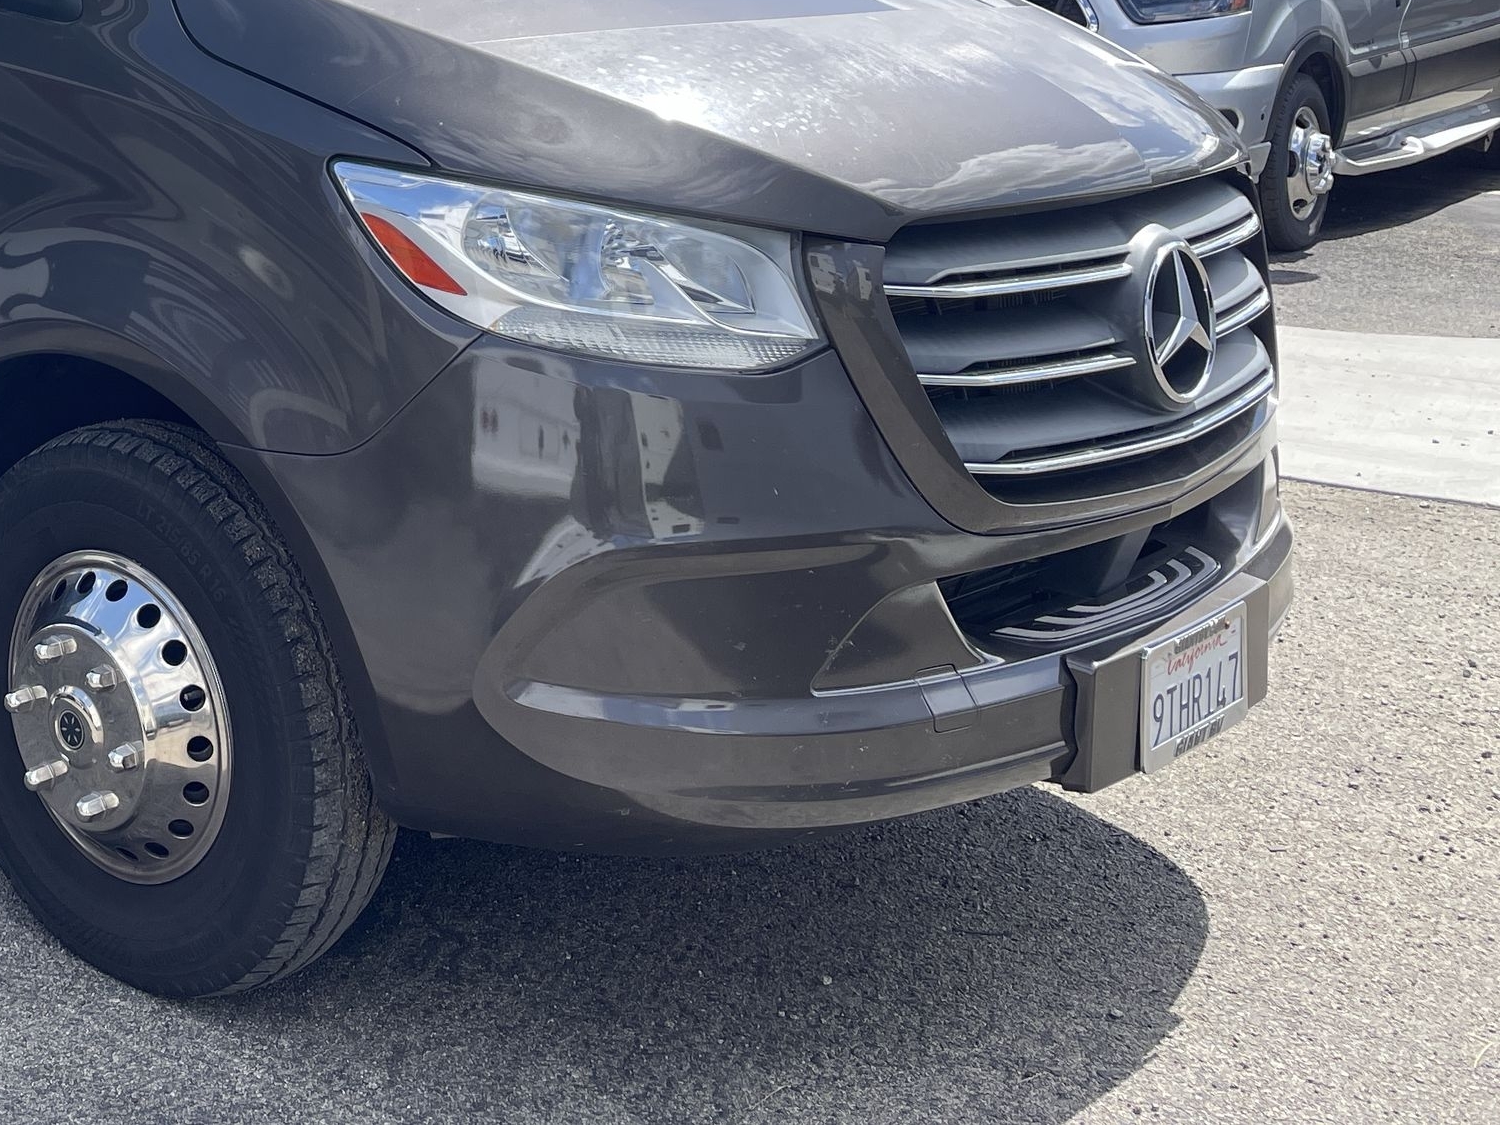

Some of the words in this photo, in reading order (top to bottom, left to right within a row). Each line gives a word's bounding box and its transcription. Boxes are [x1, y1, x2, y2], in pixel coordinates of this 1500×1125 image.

[1167, 634, 1228, 675] California
[1152, 651, 1240, 748] 9THR147
[1174, 722, 1209, 757] GIANT
[1208, 713, 1225, 738] RV
